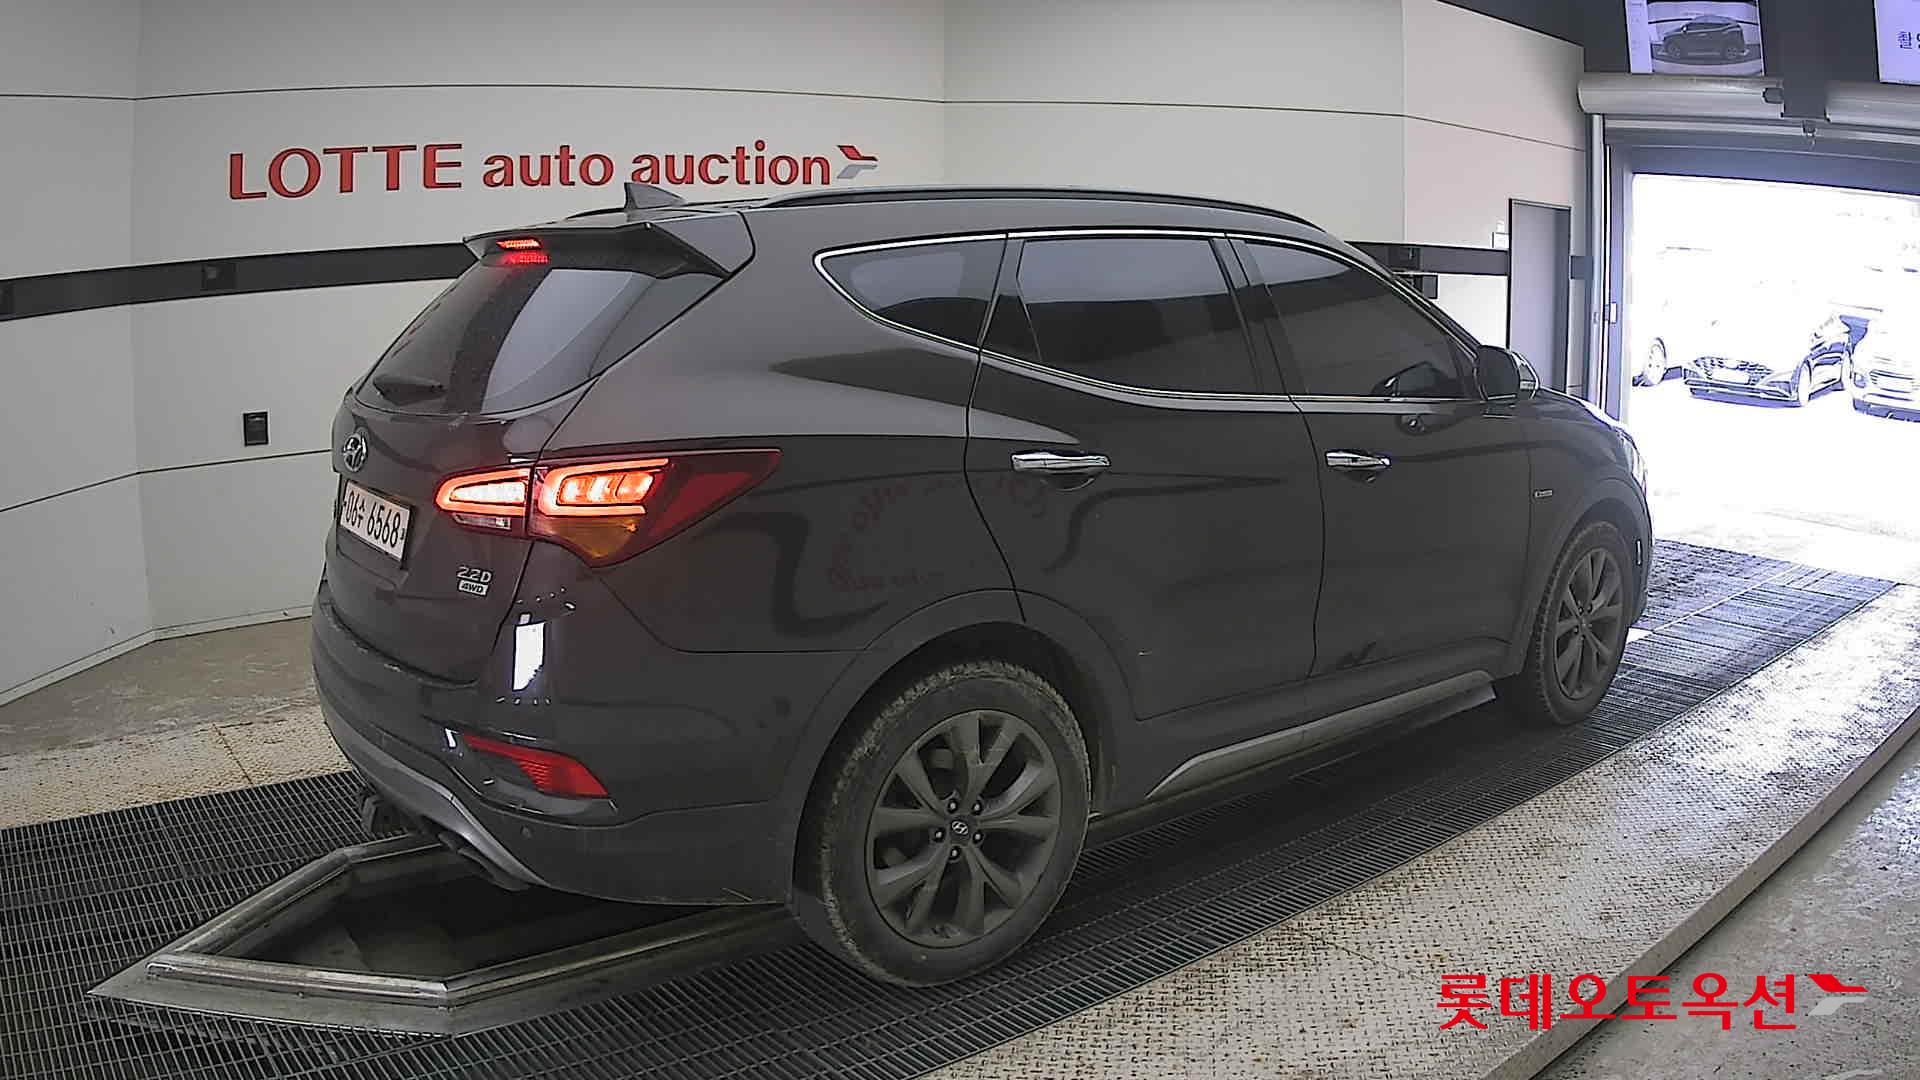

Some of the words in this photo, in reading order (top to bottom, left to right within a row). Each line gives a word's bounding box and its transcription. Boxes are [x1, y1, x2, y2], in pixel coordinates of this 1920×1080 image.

[229, 143, 463, 200] LOTTE
[482, 145, 616, 187] auto
[631, 140, 831, 186] auction
[367, 501, 401, 548] 6568
